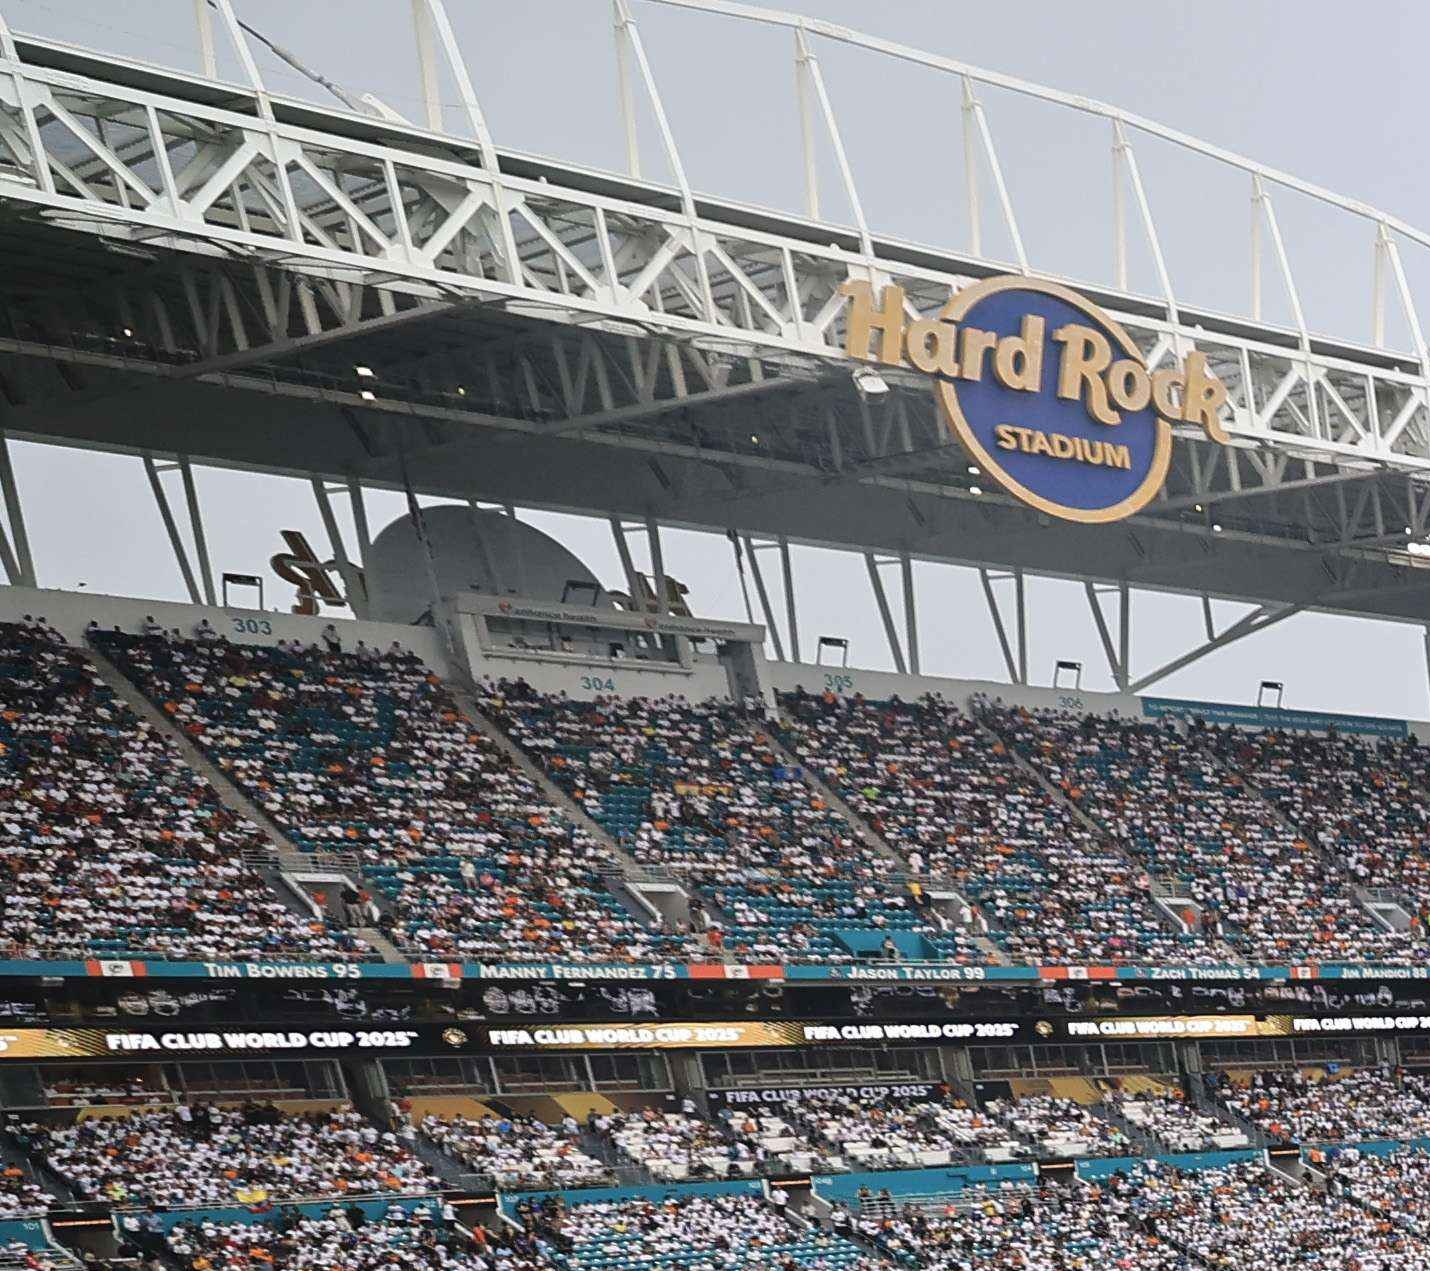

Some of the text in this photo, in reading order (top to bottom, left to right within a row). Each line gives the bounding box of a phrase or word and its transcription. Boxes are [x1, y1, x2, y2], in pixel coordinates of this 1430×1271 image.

[837, 279, 1230, 445] Hard Rock
[994, 424, 1131, 470] STADIUM
[232, 617, 272, 636] 303
[581, 675, 615, 691] 304
[204, 962, 361, 978] TIM BOWENS 95
[480, 964, 676, 978] MANNY FERNANDEZ 75
[847, 965, 985, 979] JASON TAYLOR 99
[804, 1026, 839, 1039] FIFA
[840, 1026, 886, 1039] CLUB
[886, 1025, 941, 1038] WORLD
[944, 1024, 974, 1037] CUP
[106, 1034, 160, 1049] FIFA
[162, 1034, 223, 1049] CLUB
[224, 1033, 307, 1048] WORLD
[311, 1032, 354, 1047] CUP
